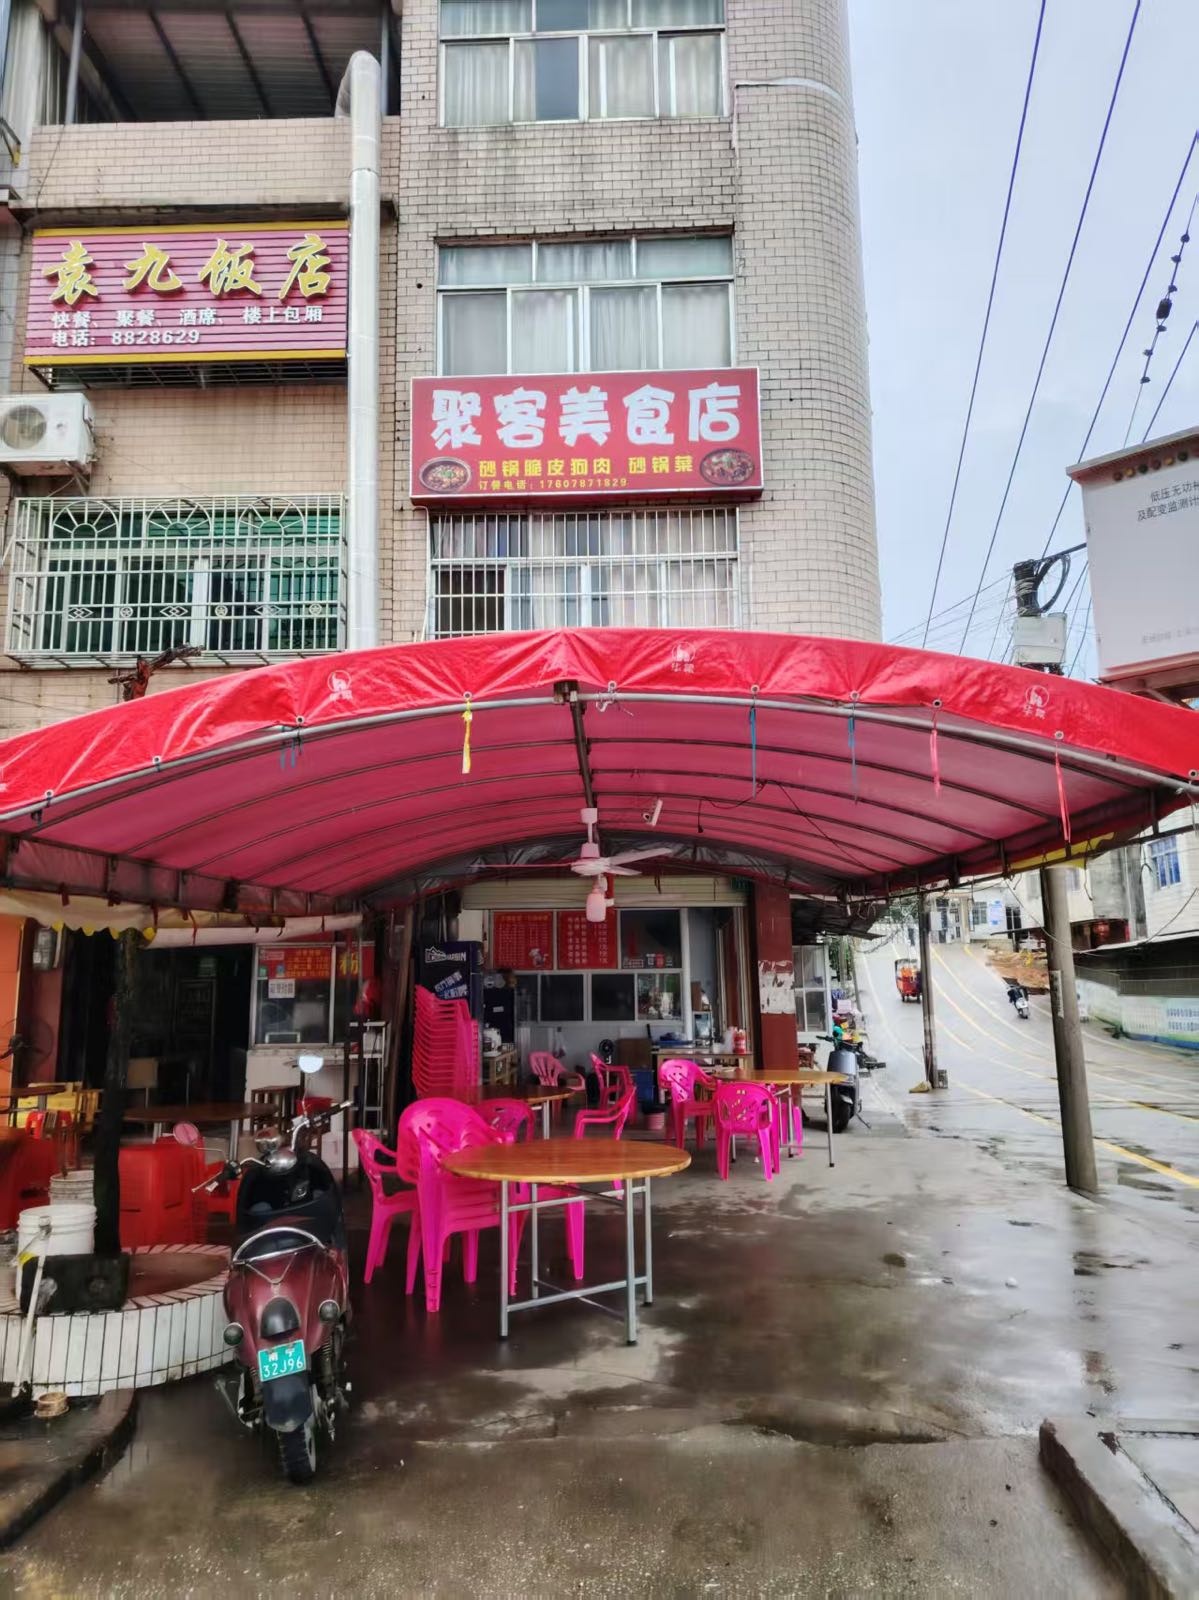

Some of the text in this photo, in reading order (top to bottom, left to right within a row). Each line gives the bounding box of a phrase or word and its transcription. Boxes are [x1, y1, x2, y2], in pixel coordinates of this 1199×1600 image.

[43, 233, 332, 305] 袁九饭店
[243, 305, 323, 324] 楼上包厢
[111, 330, 200, 345] 8828629
[431, 381, 741, 450] 聚客美食店
[479, 455, 694, 477] 砂锅脆皮狗肉 砂锅菜
[263, 1356, 303, 1378] 32J96
